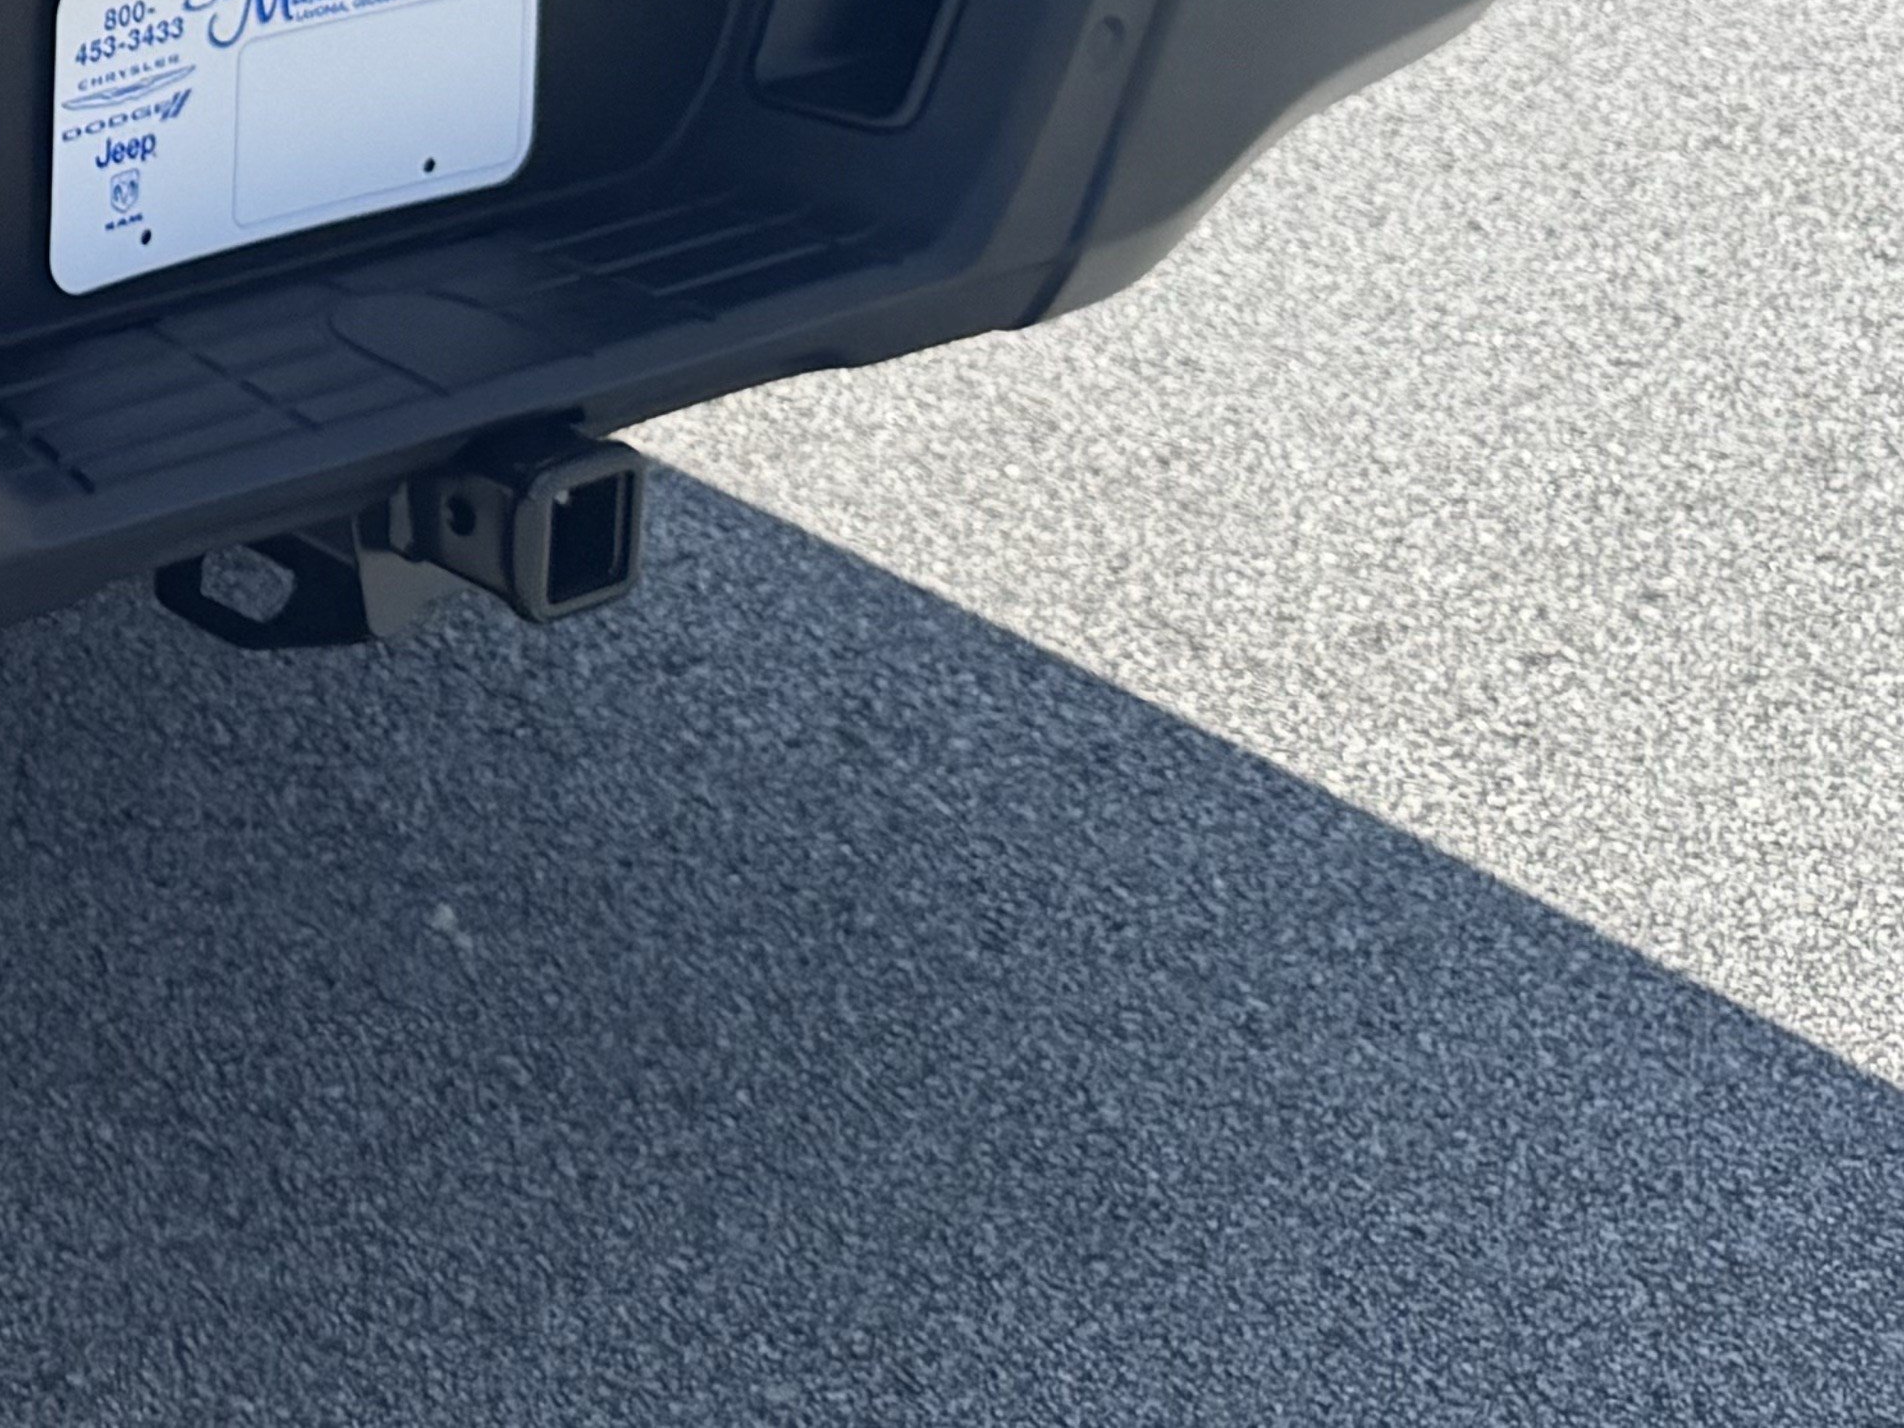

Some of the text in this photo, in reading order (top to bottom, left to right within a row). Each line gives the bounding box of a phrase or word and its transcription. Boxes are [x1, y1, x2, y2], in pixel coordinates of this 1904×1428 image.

[103, 0, 157, 32] 800-
[74, 16, 185, 66] 453-3433
[77, 53, 181, 92] CHRYSLER
[95, 132, 157, 169] Jeep
